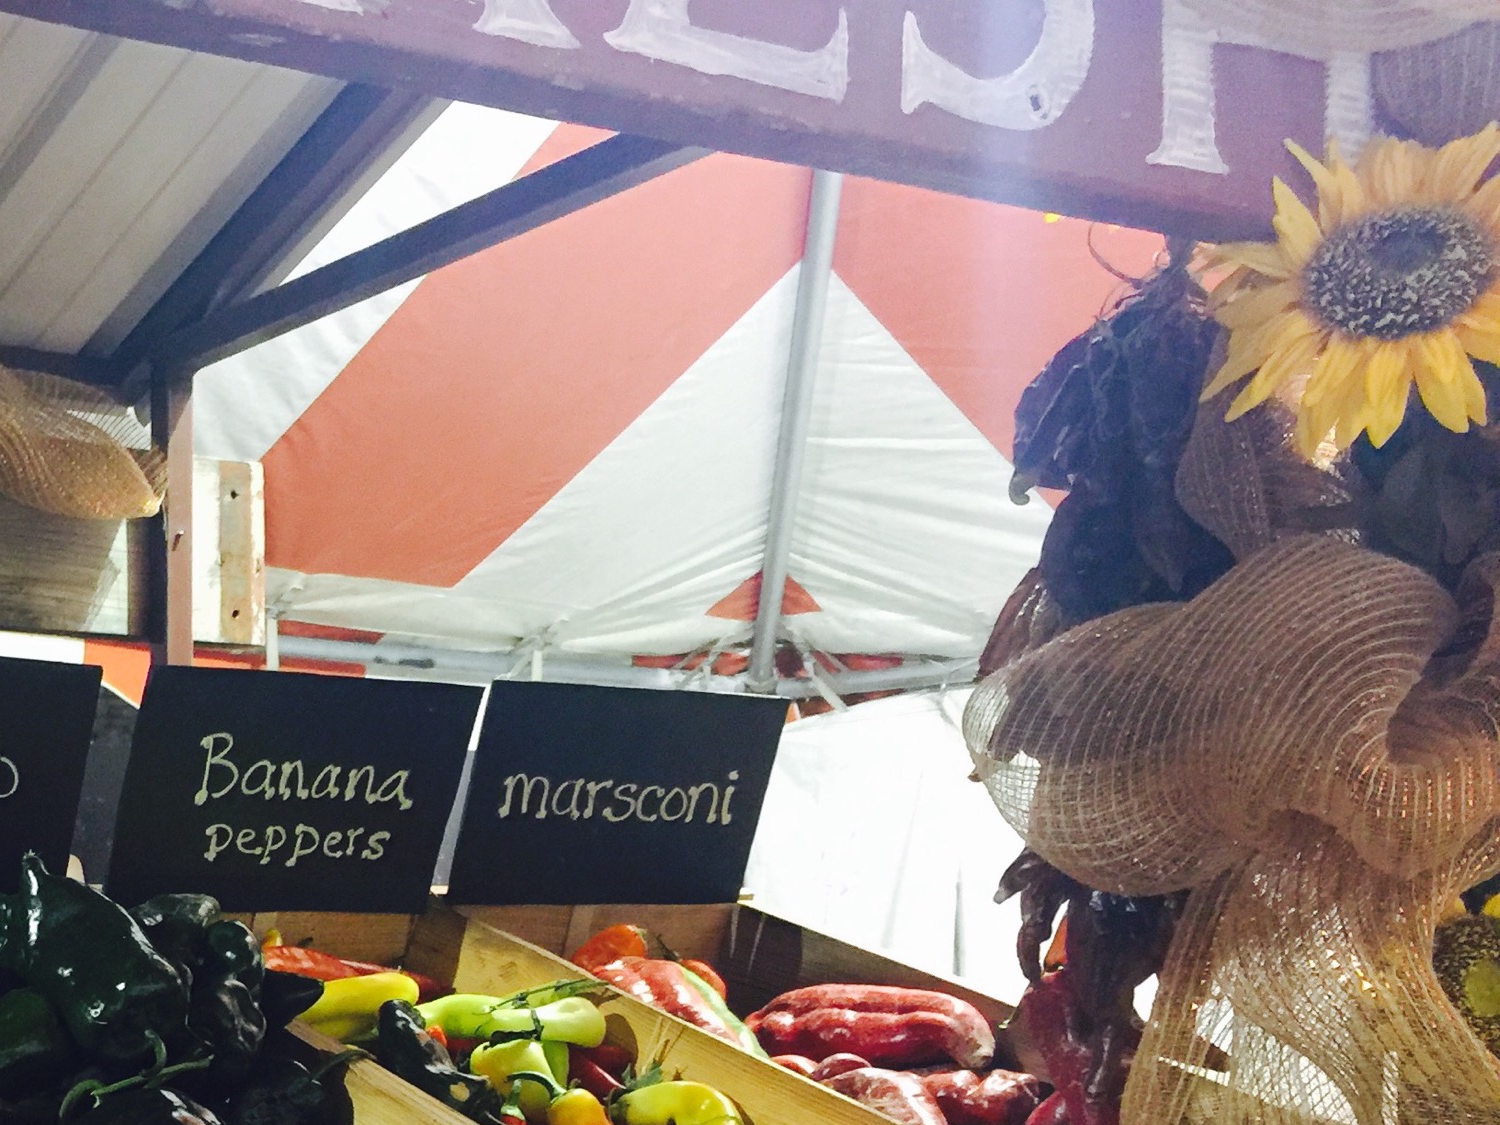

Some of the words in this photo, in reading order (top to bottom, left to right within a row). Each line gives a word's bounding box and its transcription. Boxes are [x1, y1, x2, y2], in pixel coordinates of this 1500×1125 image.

[193, 731, 414, 811] Banana
[497, 769, 740, 827] marsconi
[203, 822, 392, 868] peppers
